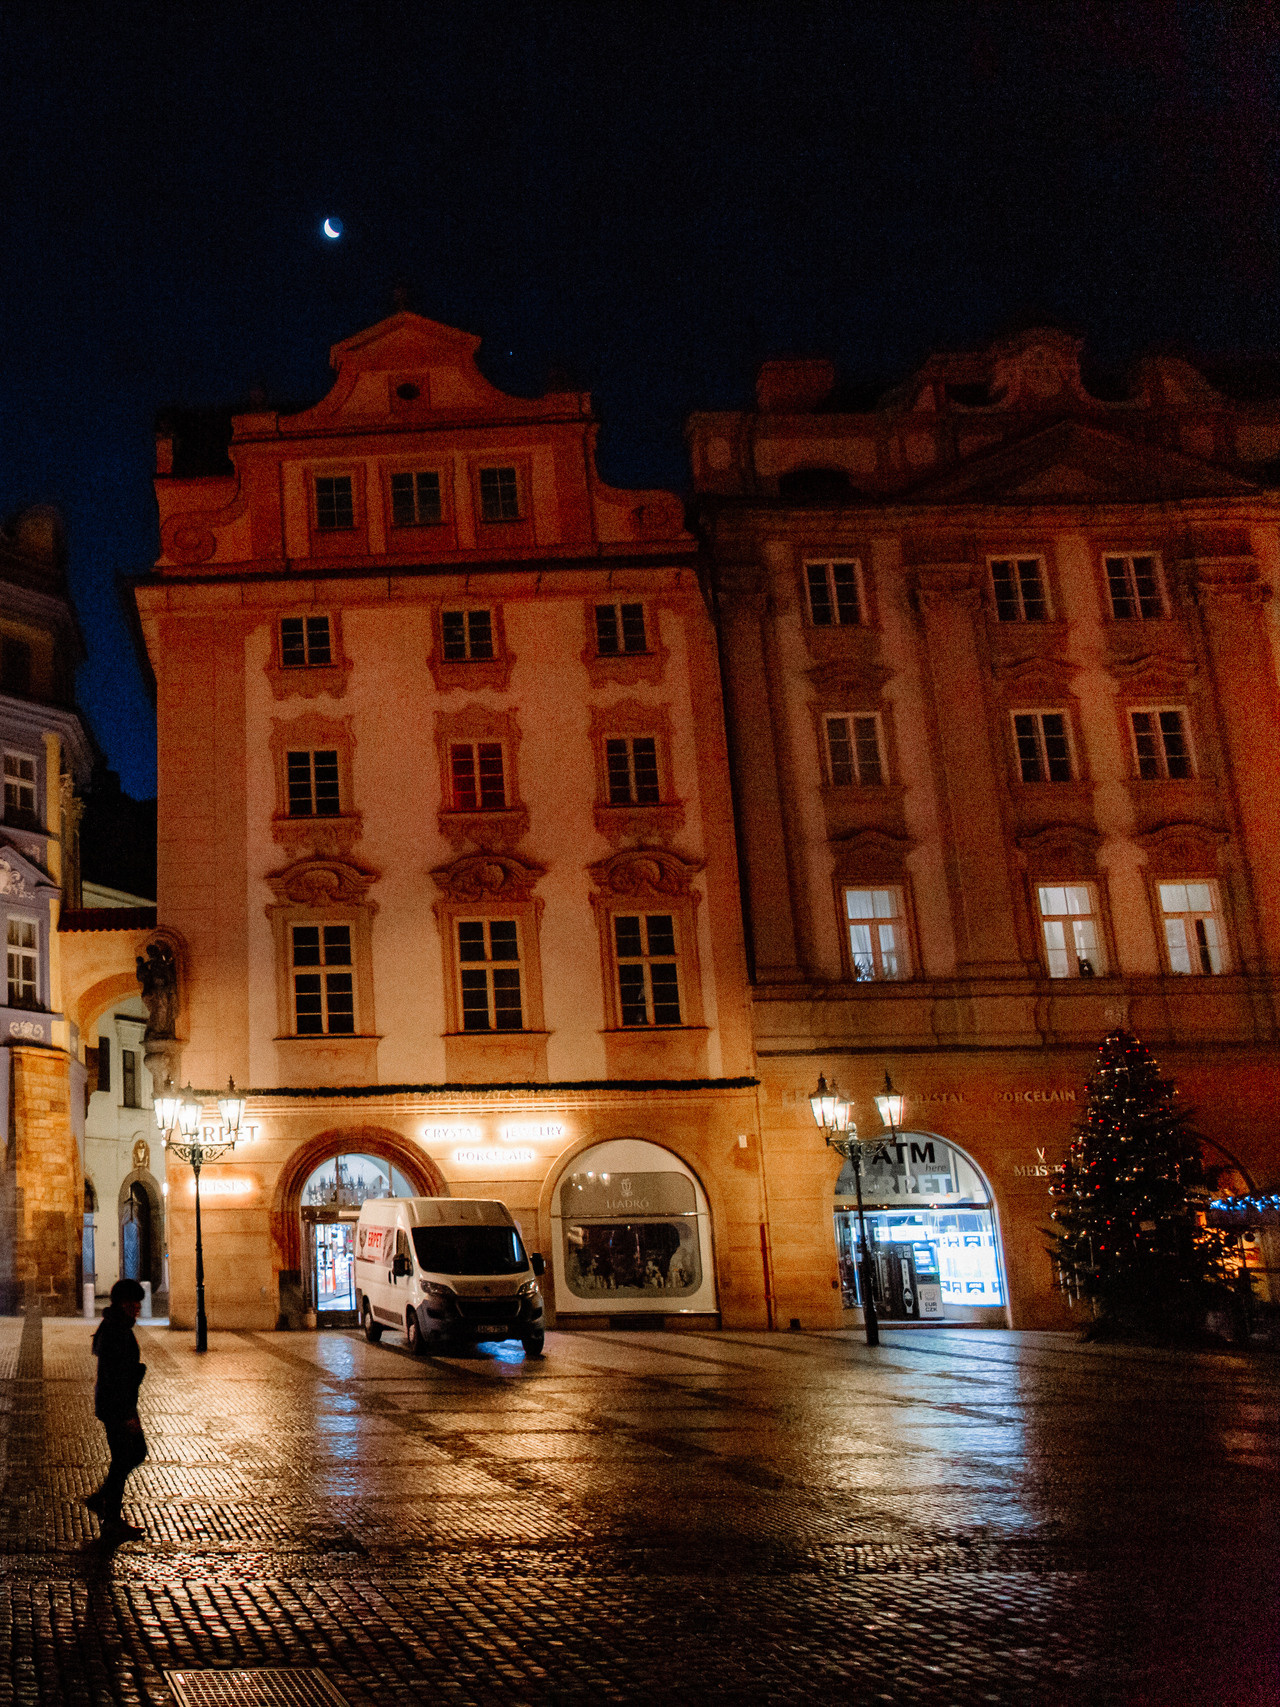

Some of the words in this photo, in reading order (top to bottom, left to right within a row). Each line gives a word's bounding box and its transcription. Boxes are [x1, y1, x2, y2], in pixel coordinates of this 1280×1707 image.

[996, 1090, 1077, 1102] PORCELAIN
[424, 1127, 482, 1138] CRYSTAL
[505, 1125, 563, 1139] JEWELRY
[457, 1150, 533, 1161] PORCELAIN
[872, 1142, 936, 1165] ATM
[925, 1164, 948, 1172] here
[1014, 1165, 1066, 1176] MEISSE
